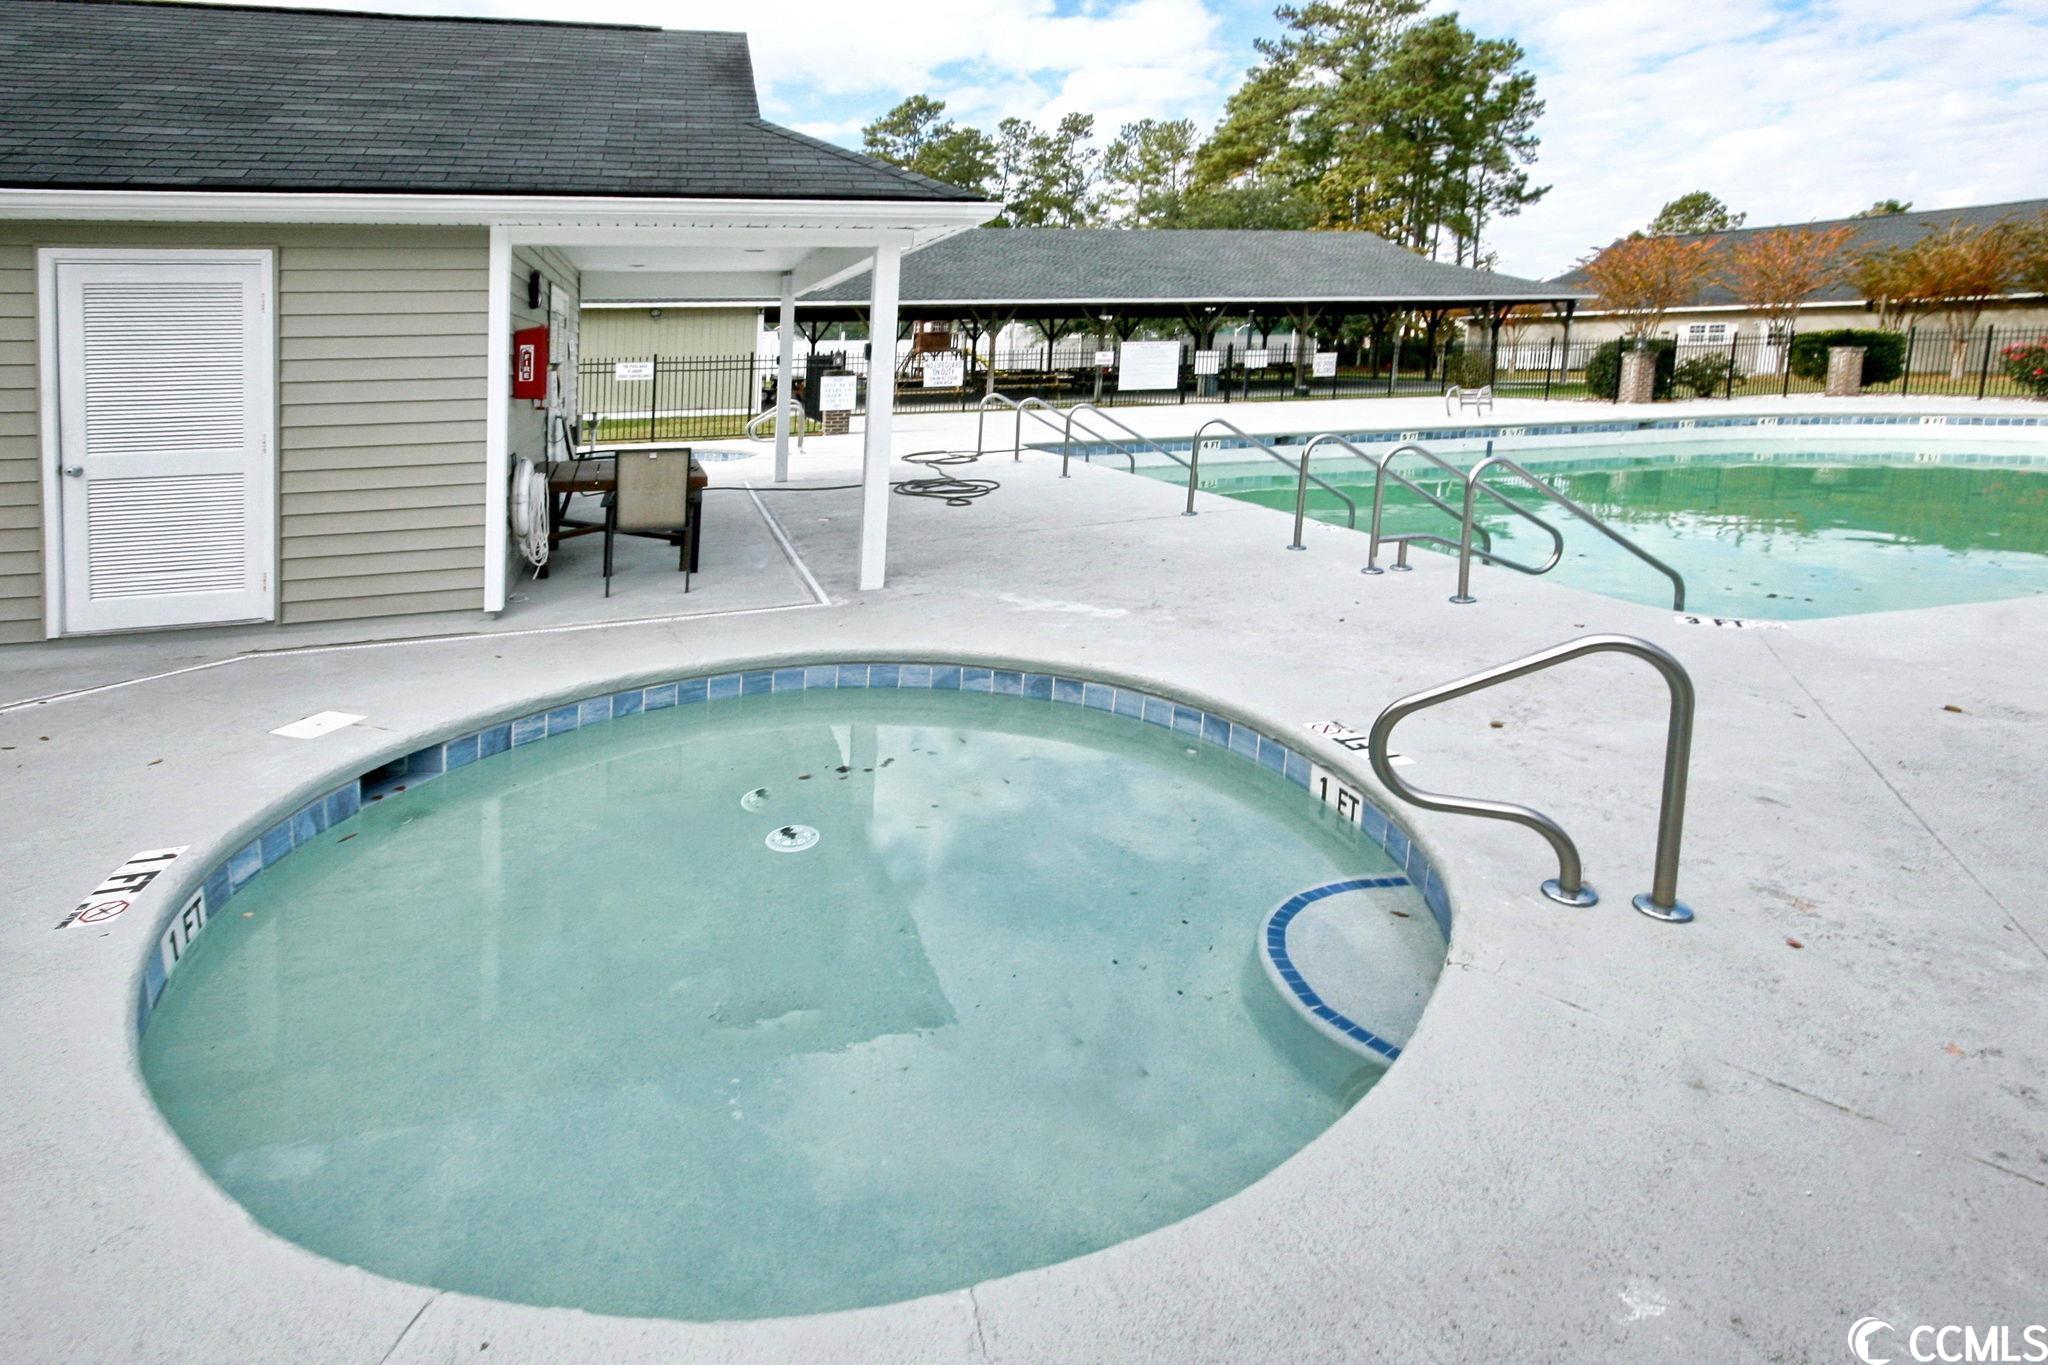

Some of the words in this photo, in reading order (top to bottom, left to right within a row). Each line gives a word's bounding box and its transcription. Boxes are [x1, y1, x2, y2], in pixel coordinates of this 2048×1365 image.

[523, 353, 531, 379] FIRE
[926, 361, 933, 369] NO
[1203, 441, 1209, 449] 4
[1211, 440, 1219, 449] FT
[1320, 776, 1328, 802] 1
[1337, 787, 1360, 822] FT
[126, 852, 178, 865] 1
[91, 870, 162, 896] FT
[169, 929, 179, 962] 1
[182, 896, 203, 944] FT
